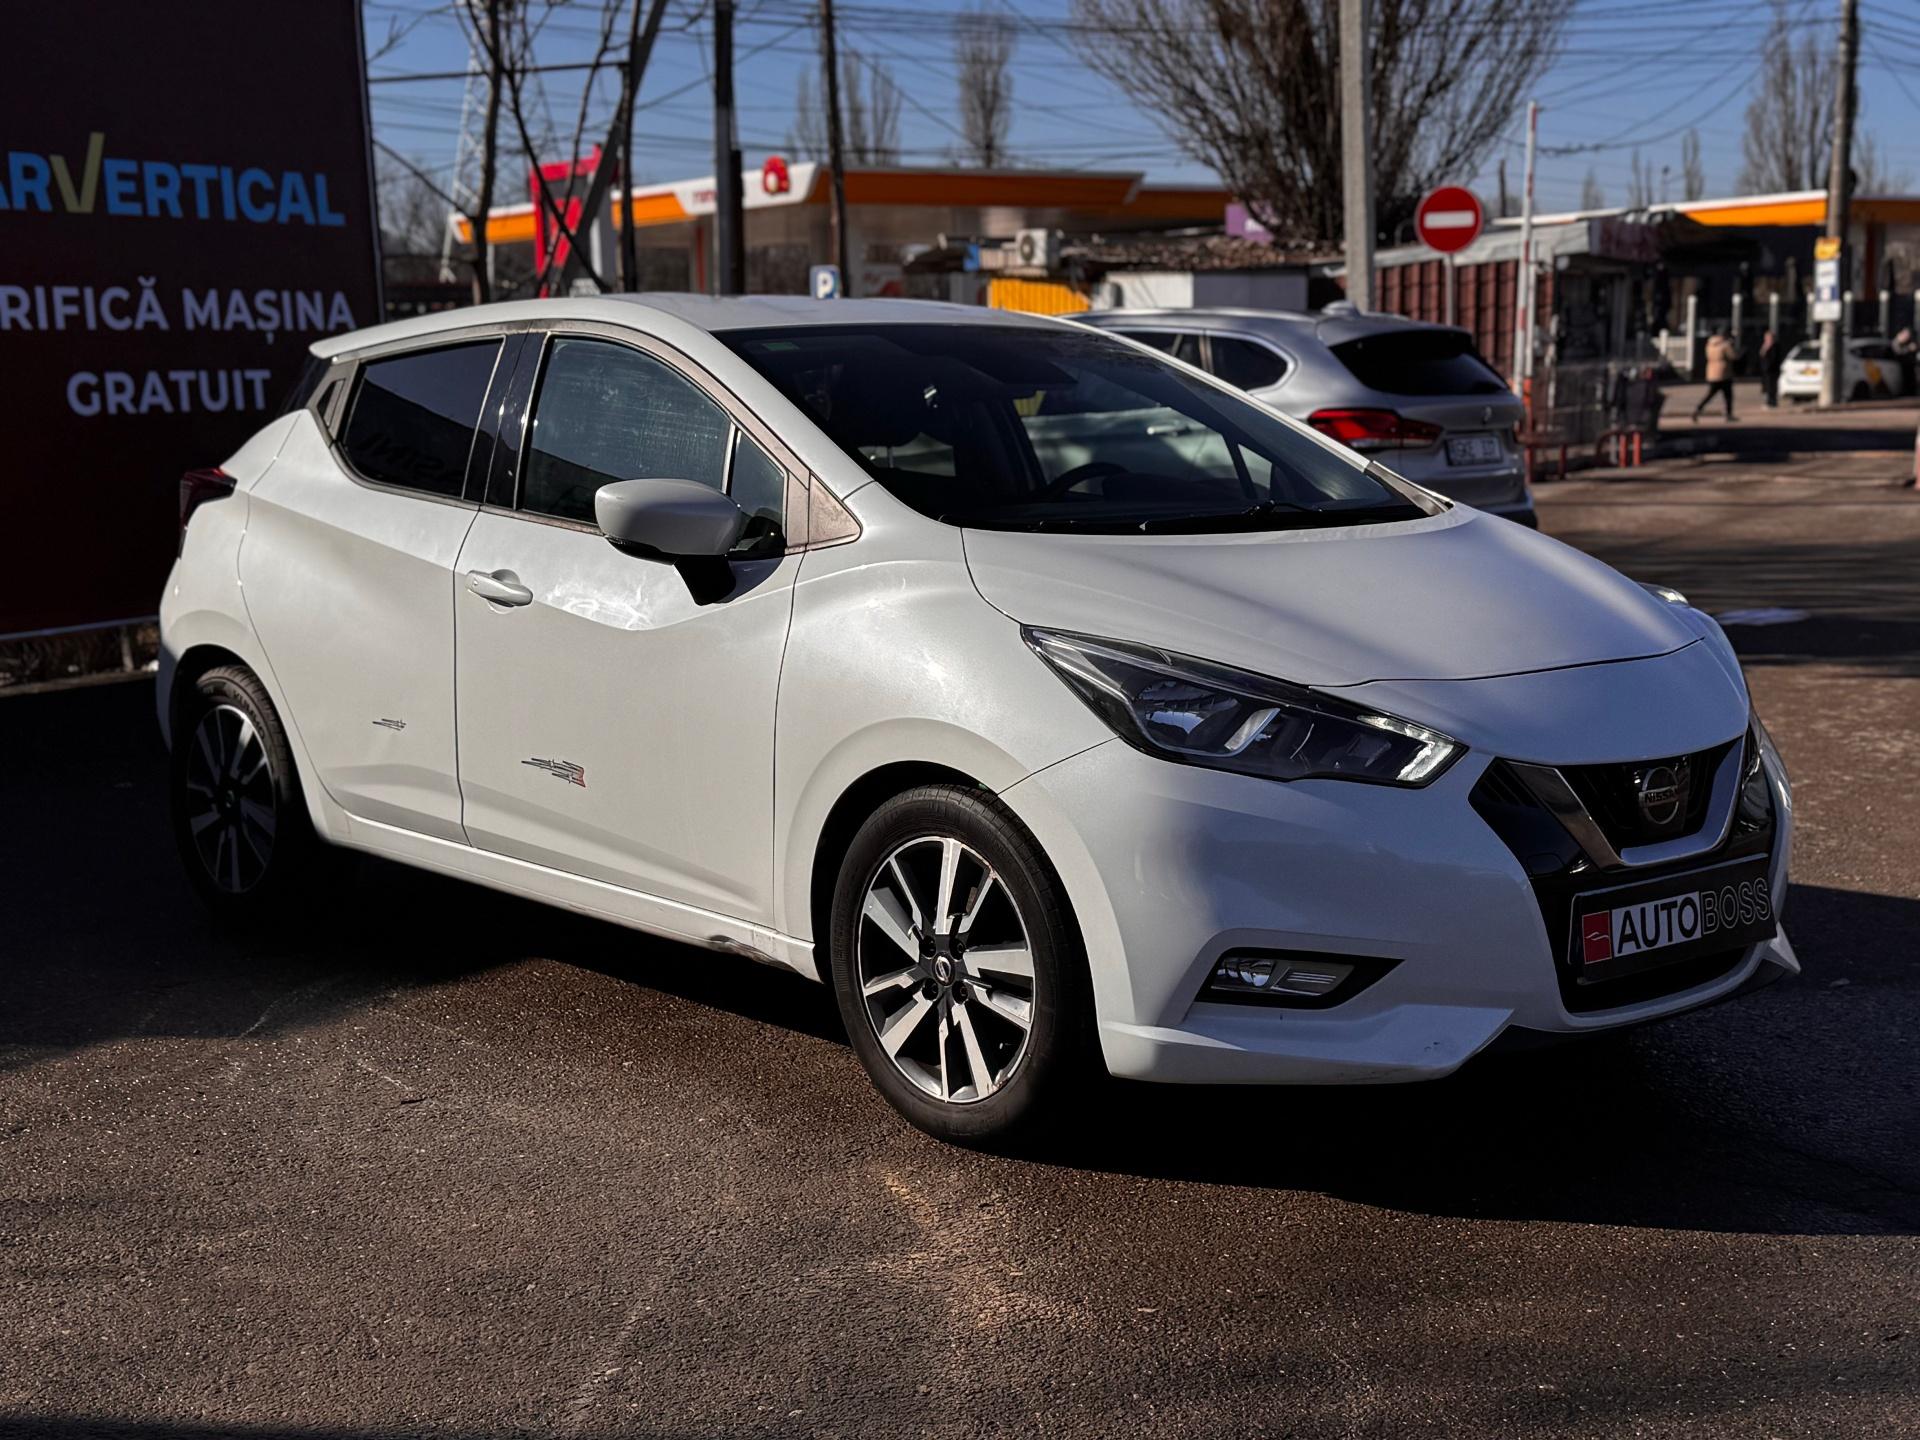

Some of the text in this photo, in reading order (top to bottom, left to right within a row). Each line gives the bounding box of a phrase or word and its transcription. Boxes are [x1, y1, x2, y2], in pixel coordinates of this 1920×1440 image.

[0, 132, 346, 226] RVERTICAL
[816, 271, 834, 299] P
[182, 288, 356, 344] MAȘINA
[66, 370, 271, 417] GRATUIT
